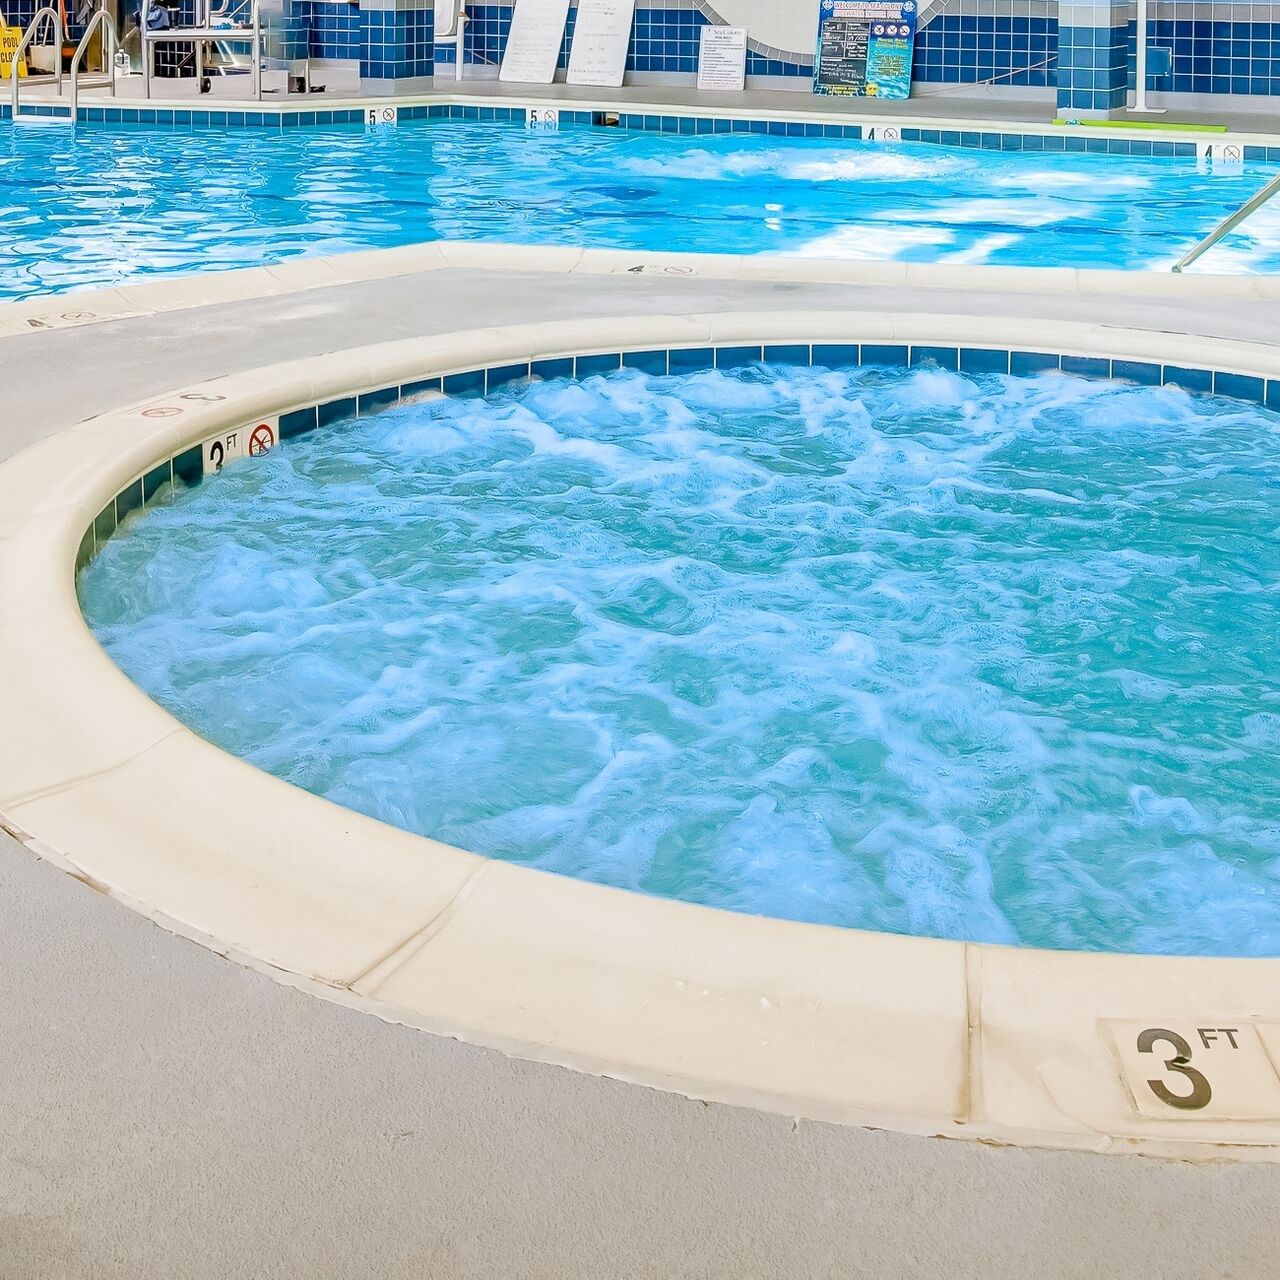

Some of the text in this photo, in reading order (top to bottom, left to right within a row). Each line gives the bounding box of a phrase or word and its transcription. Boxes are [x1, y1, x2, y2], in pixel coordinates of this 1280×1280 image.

[3, 37, 19, 48] POOL
[369, 110, 376, 125] 5
[226, 433, 237, 451] FT
[1137, 1028, 1239, 1111] 3 FT
